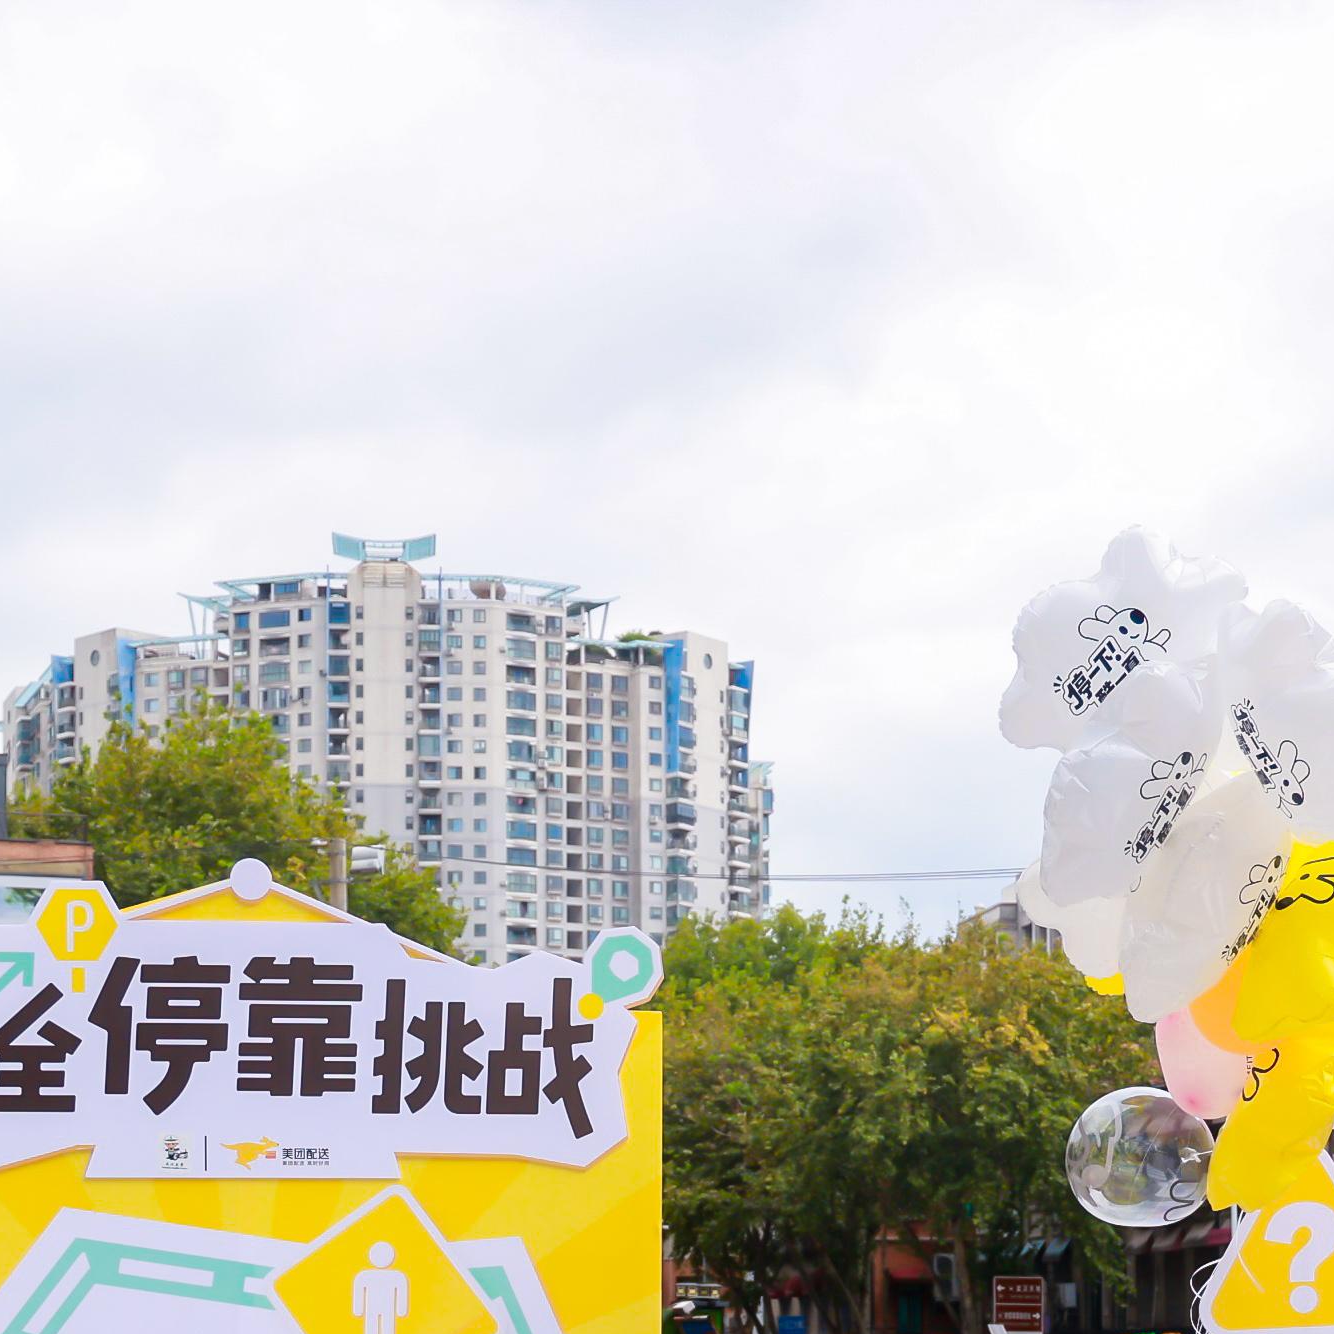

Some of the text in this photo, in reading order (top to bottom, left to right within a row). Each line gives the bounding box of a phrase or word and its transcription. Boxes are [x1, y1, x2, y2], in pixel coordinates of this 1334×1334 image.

[1067, 640, 1122, 711] 停一下!
[67, 900, 95, 953] P
[282, 1148, 330, 1160] 美团配送
